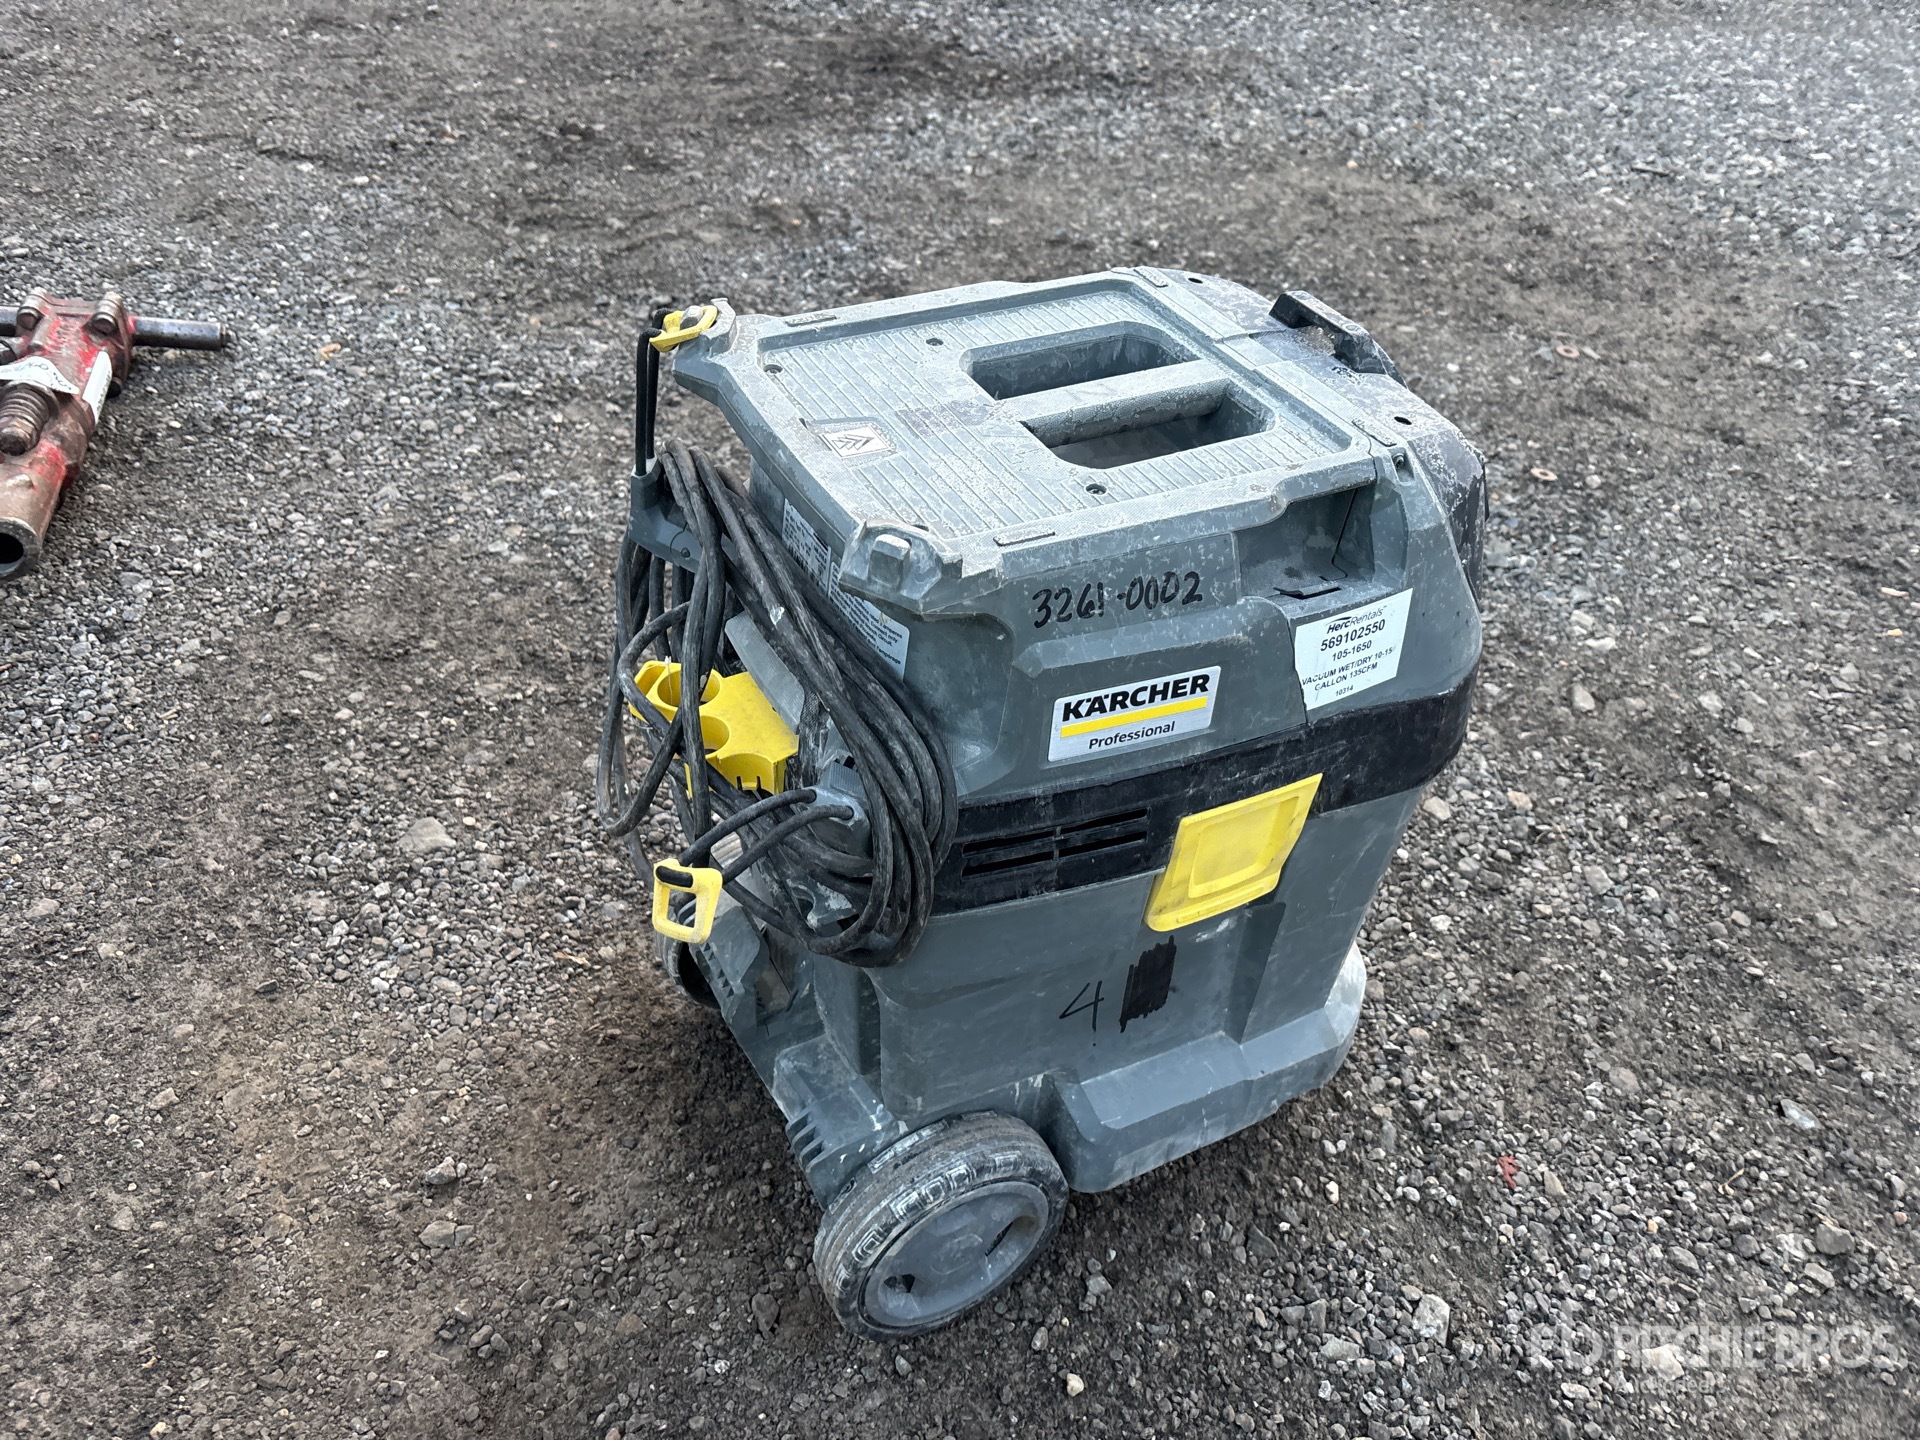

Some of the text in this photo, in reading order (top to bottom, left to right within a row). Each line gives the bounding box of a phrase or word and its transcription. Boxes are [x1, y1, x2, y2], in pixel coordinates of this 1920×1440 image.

[1032, 571, 1203, 628] 3261-0002
[1320, 618, 1386, 651] 569102550
[1327, 607, 1384, 634] HercRentals
[1332, 639, 1373, 662] 105-1650
[1301, 668, 1337, 686] VACUUM
[1338, 654, 1373, 674] WET/DRY
[1349, 662, 1378, 679] 135CFM
[1062, 674, 1211, 722] KÄRCHER
[1335, 684, 1354, 696] 10314
[1088, 721, 1176, 750] Professional
[1059, 981, 1105, 1032] 4
